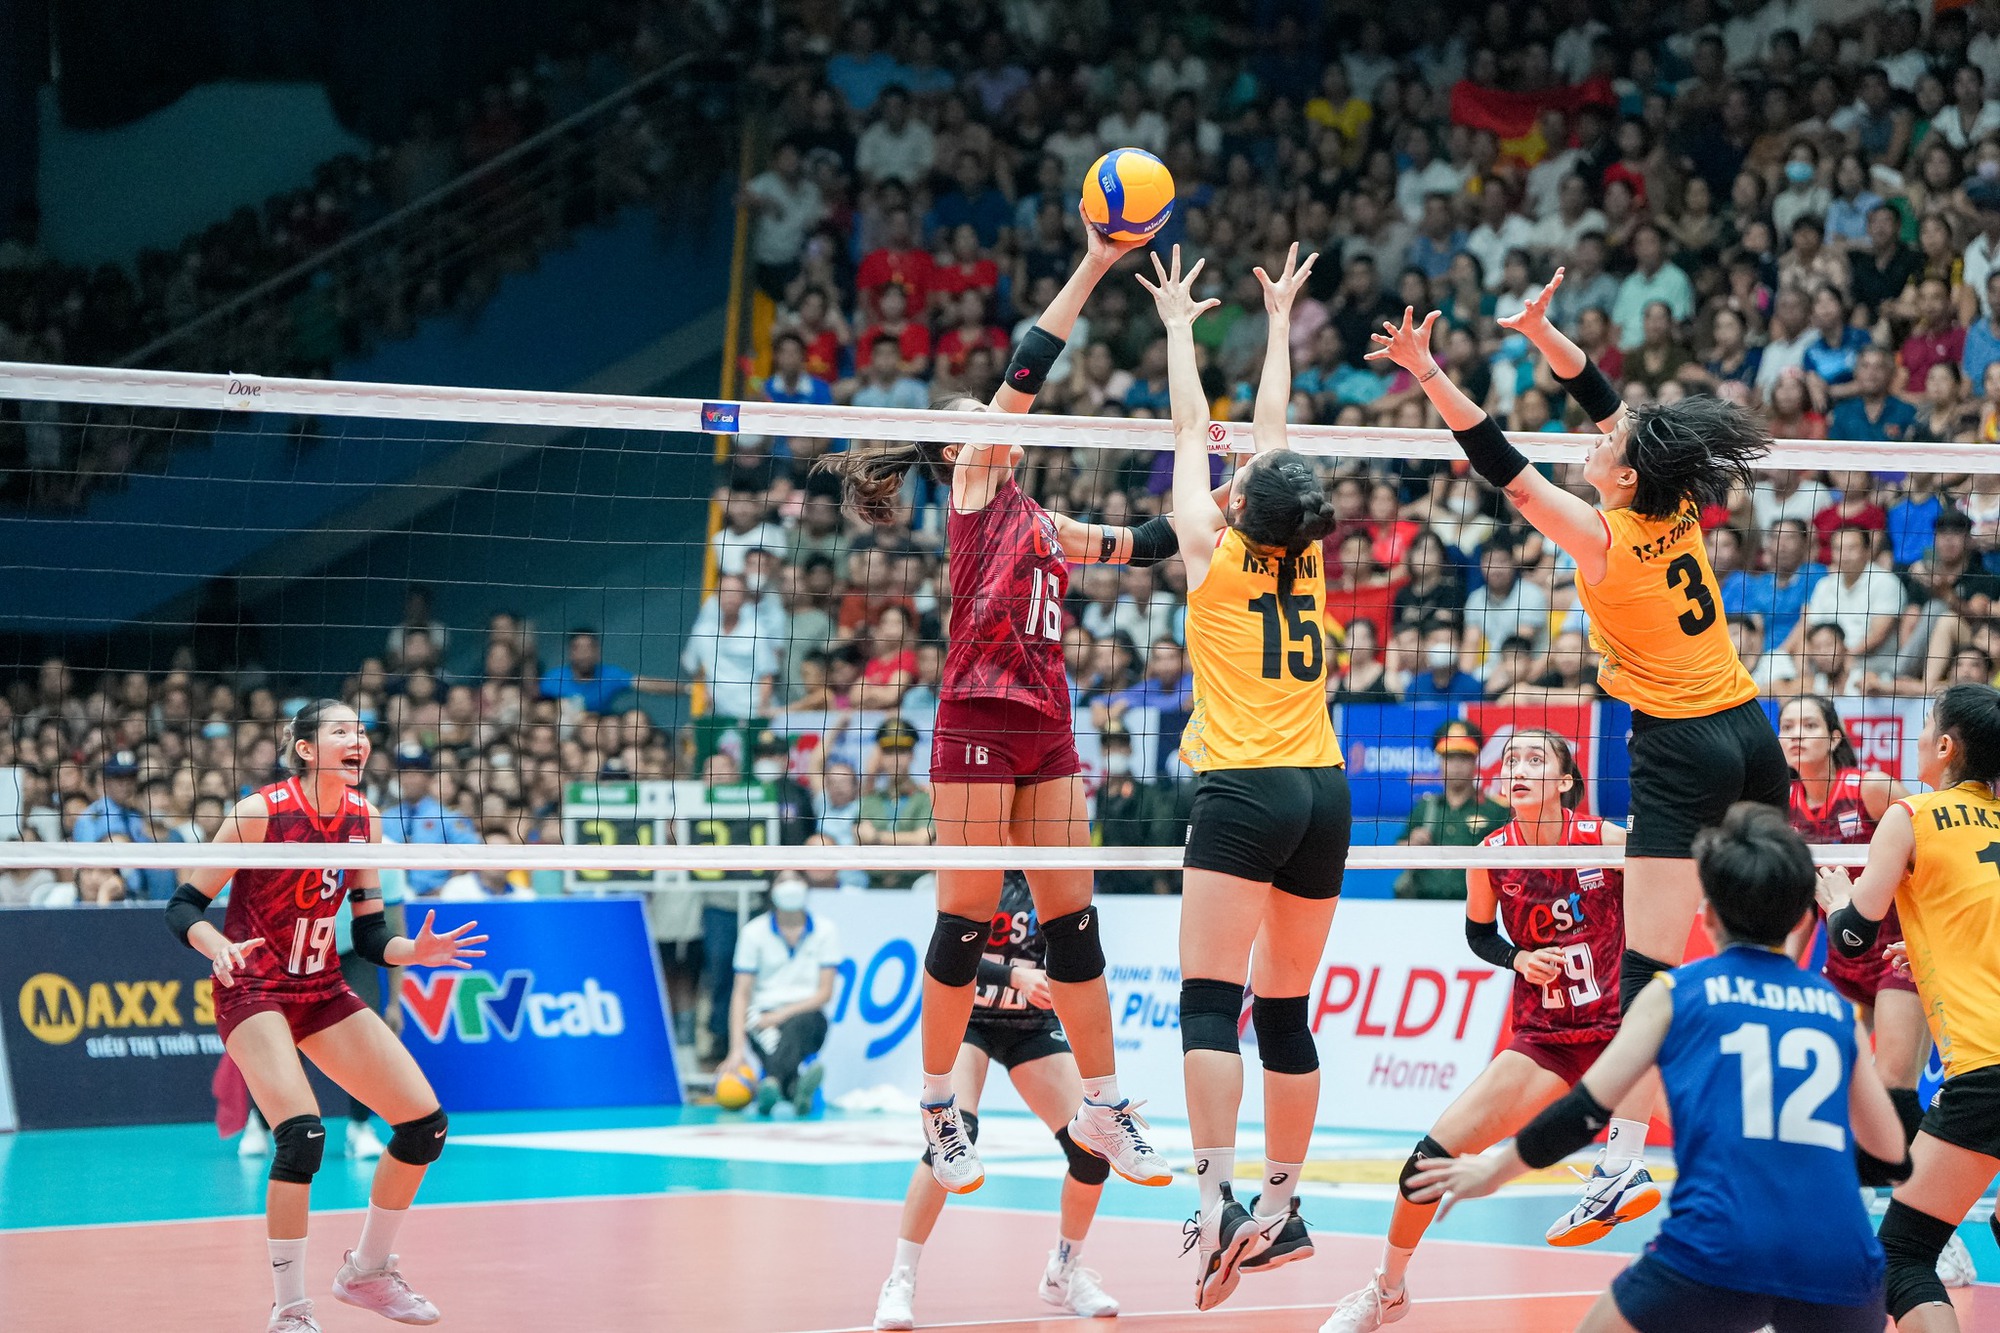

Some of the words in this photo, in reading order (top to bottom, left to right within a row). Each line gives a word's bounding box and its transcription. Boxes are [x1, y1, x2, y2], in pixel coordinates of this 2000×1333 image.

[228, 379, 261, 396] Dove
[1025, 567, 1061, 641] 16
[1666, 553, 1716, 636] 3
[1248, 592, 1323, 682] 15
[965, 743, 989, 765] 16
[288, 917, 335, 975] 19
[1529, 892, 1585, 943] est
[22, 977, 183, 1035] MAXX
[1313, 967, 1494, 1039] PLDT
[1369, 1053, 1457, 1093] Home
[1720, 1022, 1846, 1152] 12
